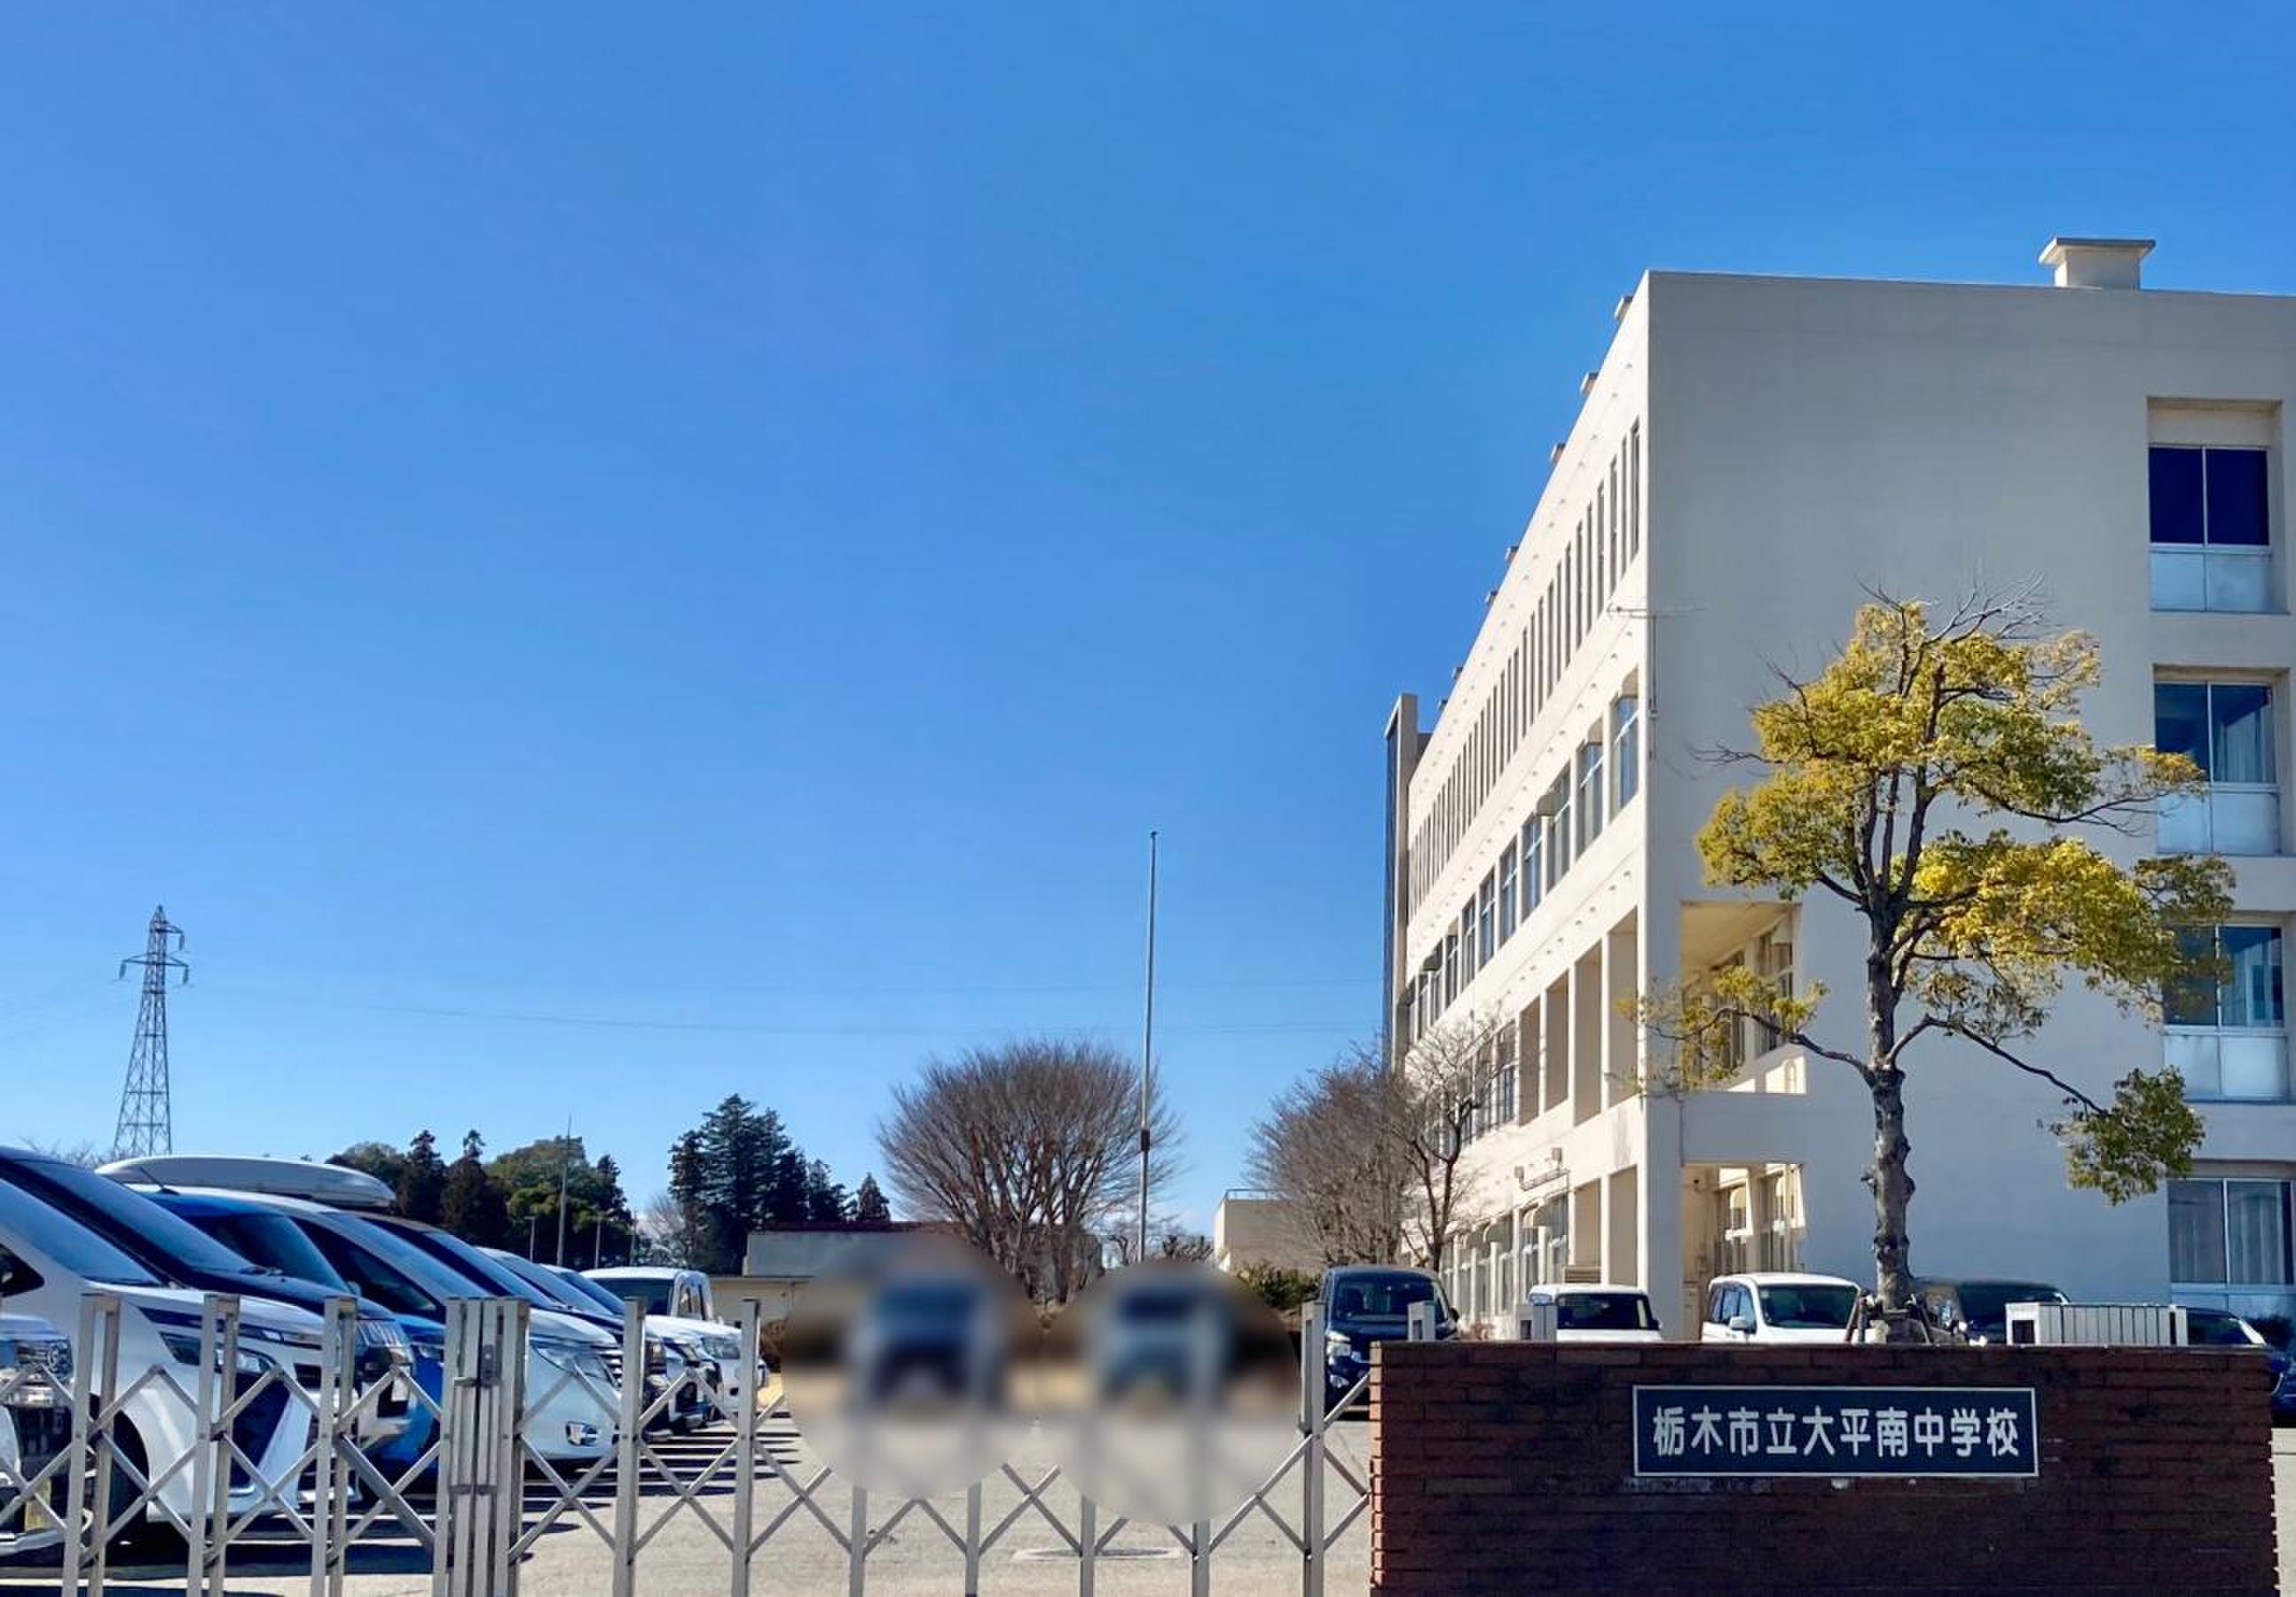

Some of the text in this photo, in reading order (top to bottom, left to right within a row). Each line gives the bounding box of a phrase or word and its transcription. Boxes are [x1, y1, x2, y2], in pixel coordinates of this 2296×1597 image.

[1653, 1404, 2020, 1458] 栃木市立大平南中学校
